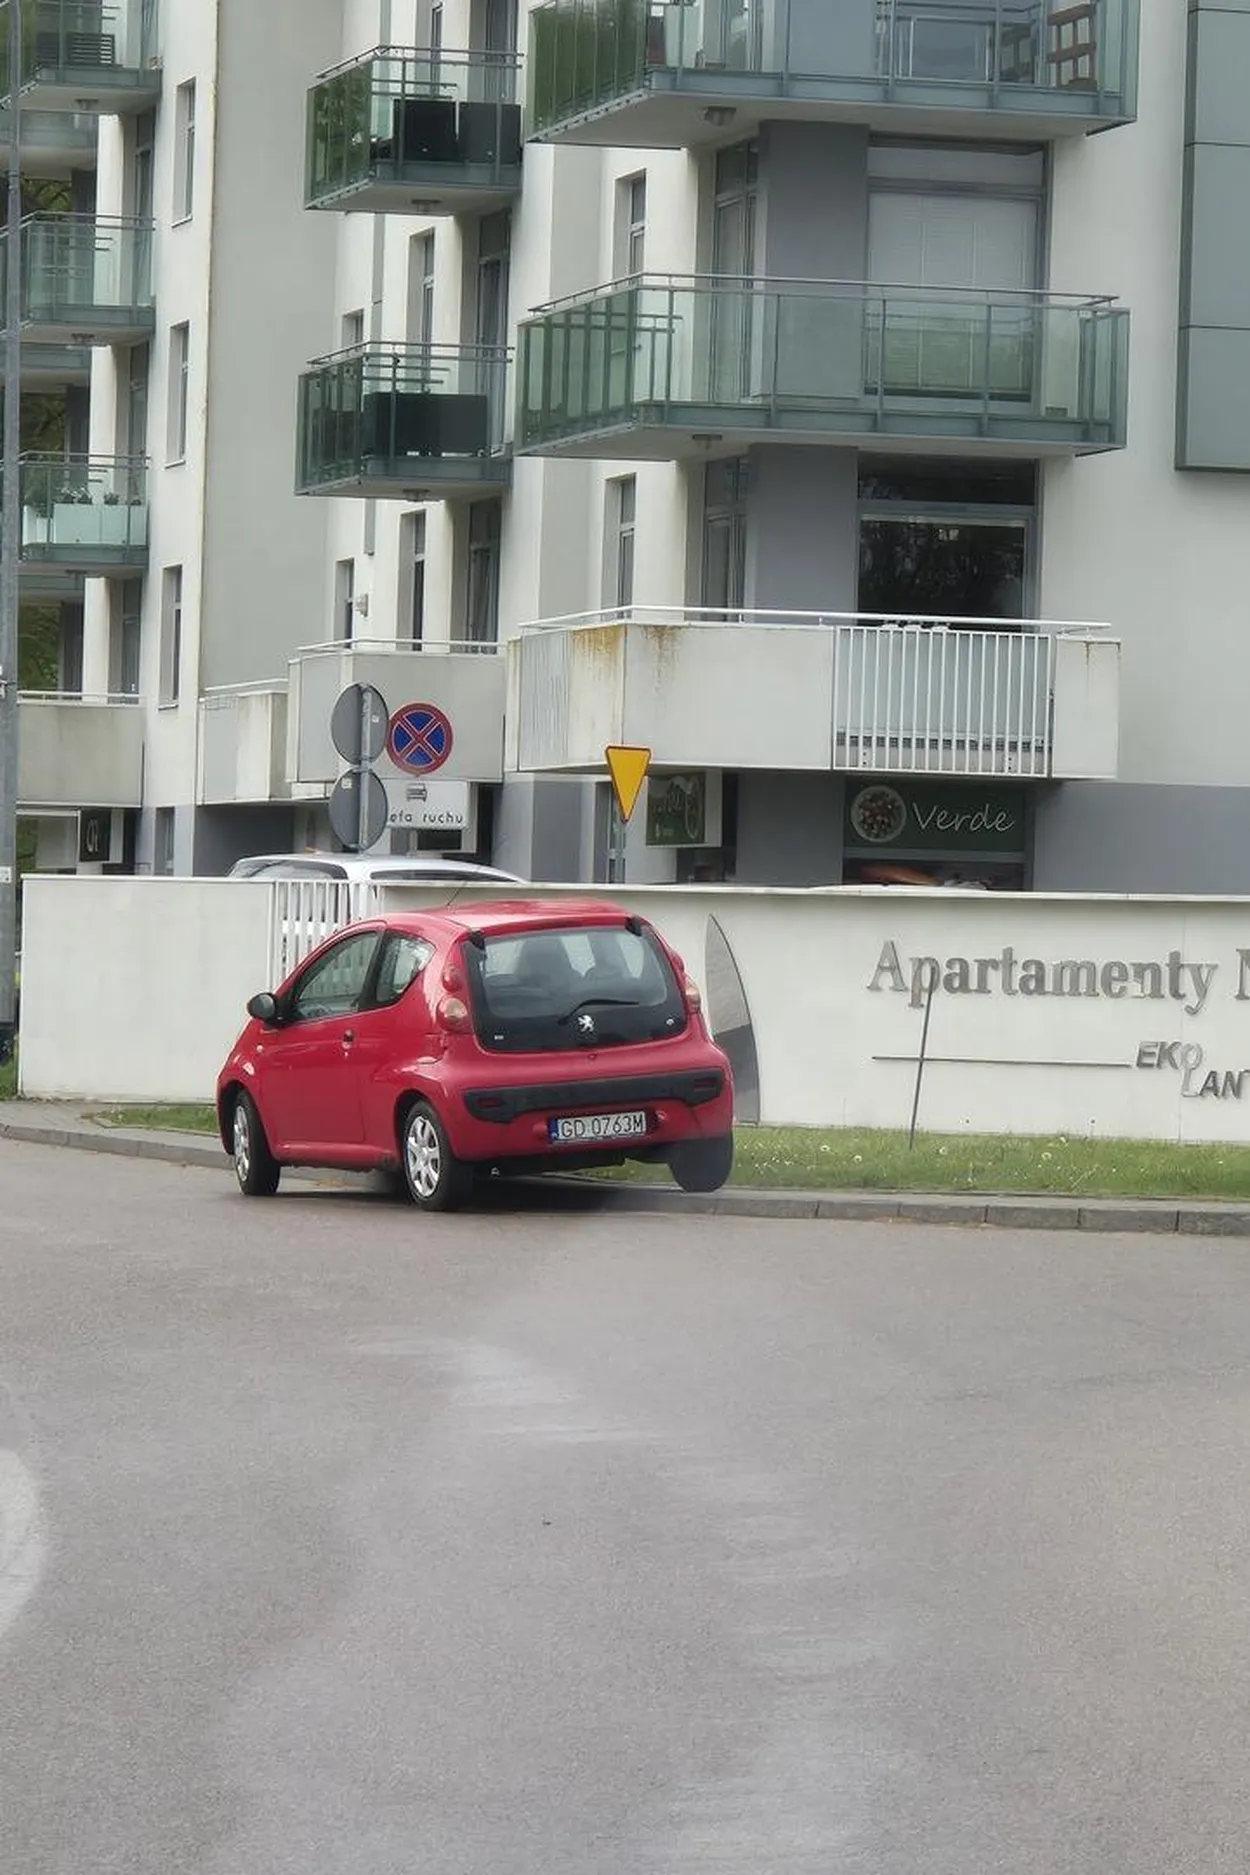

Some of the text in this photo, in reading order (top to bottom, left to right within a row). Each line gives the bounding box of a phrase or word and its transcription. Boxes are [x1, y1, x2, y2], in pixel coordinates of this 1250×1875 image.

[423, 811, 463, 824] ruchu
[912, 802, 1016, 832] Verde
[867, 940, 1218, 1015] Apartamenty
[561, 1114, 644, 1138] GD 0763M
